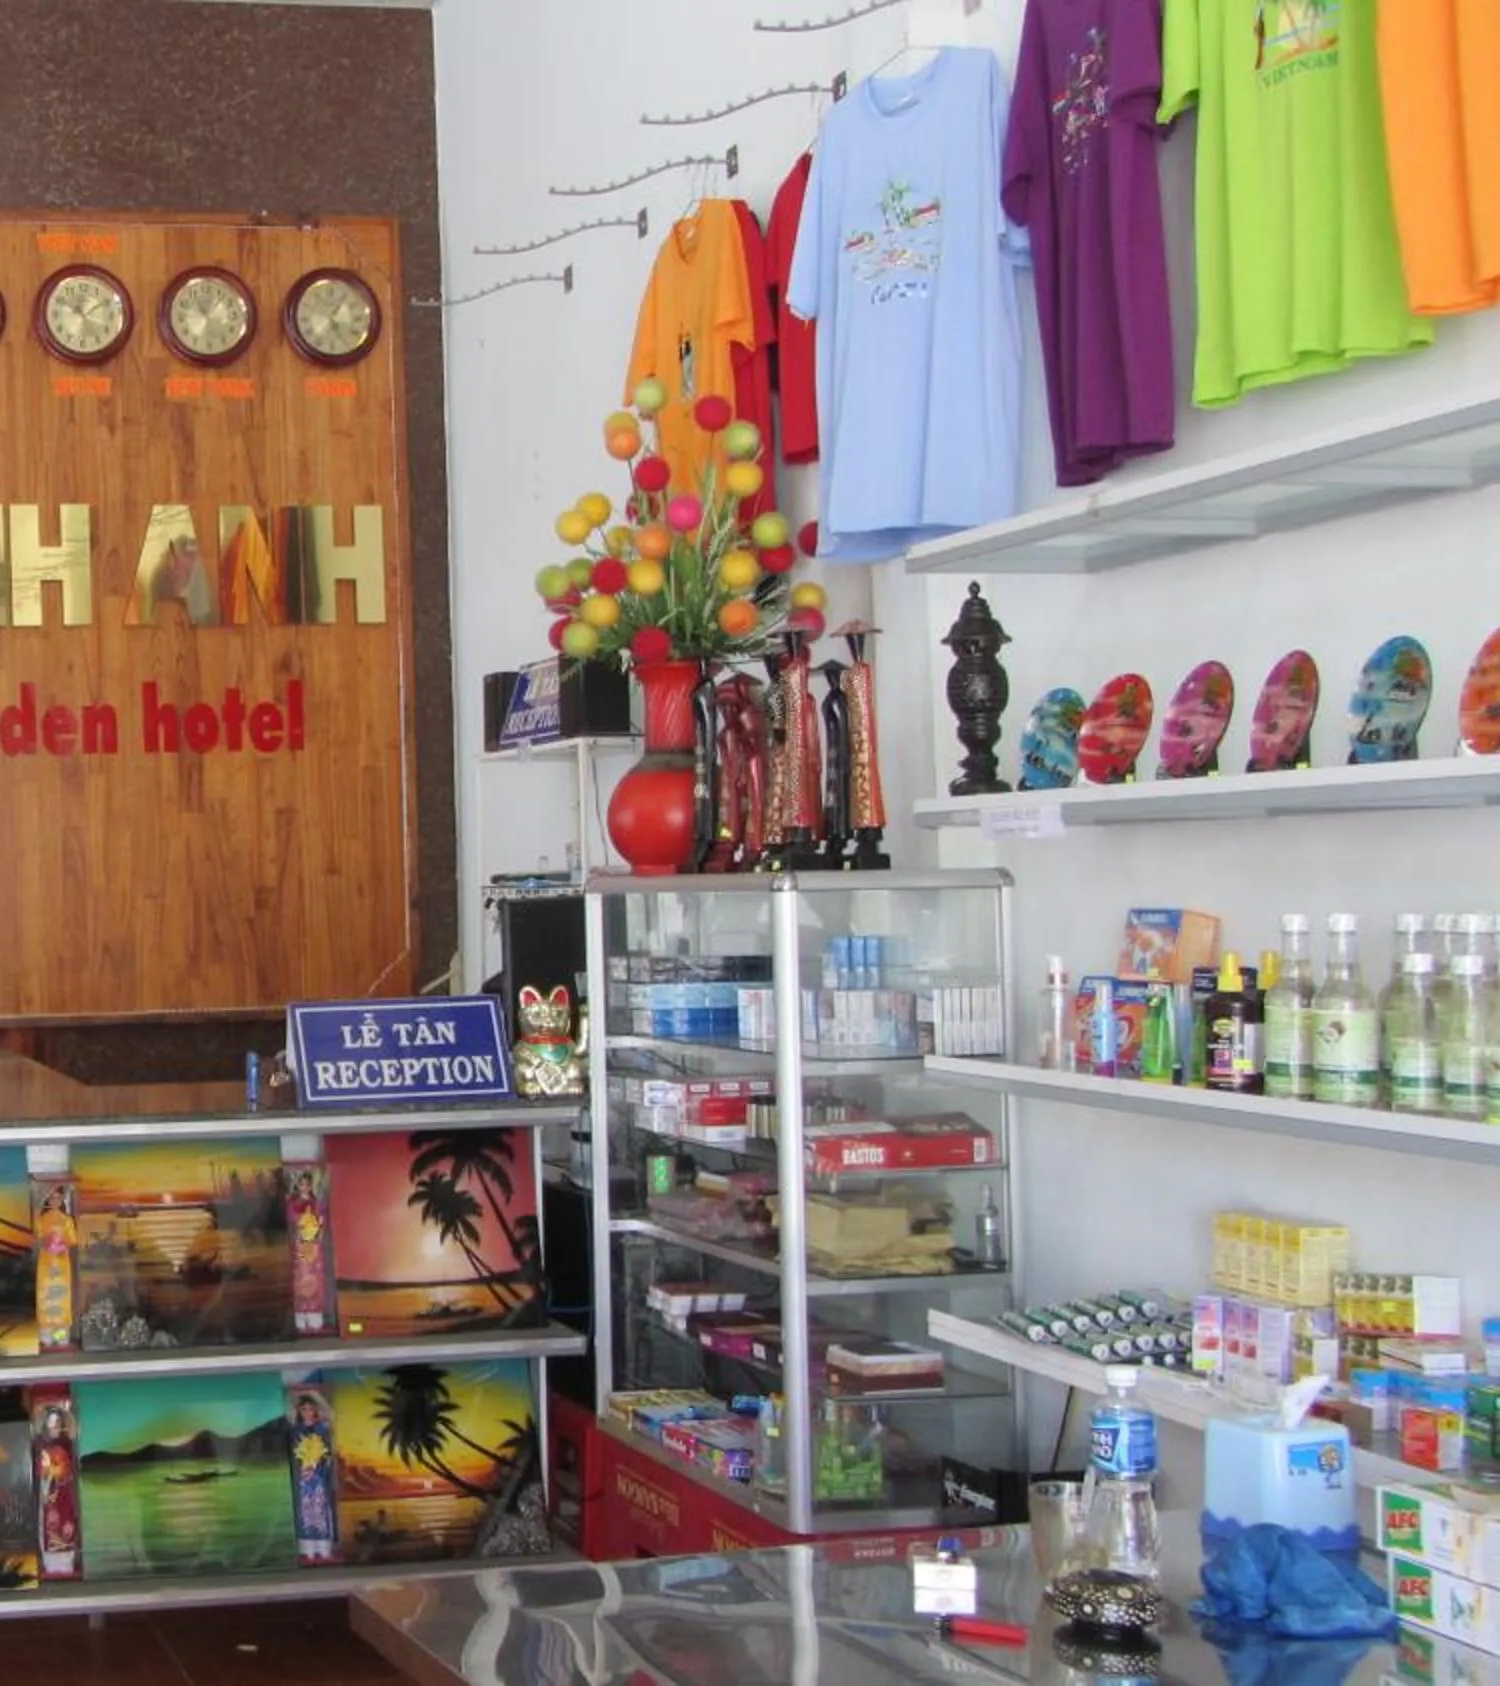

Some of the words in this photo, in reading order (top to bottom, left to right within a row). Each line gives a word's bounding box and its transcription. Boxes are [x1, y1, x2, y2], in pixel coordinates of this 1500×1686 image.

[123, 505, 386, 627] ANH
[142, 679, 305, 755] hotel
[392, 1016, 457, 1046] TÂN
[313, 1055, 496, 1091] RECEPTION
